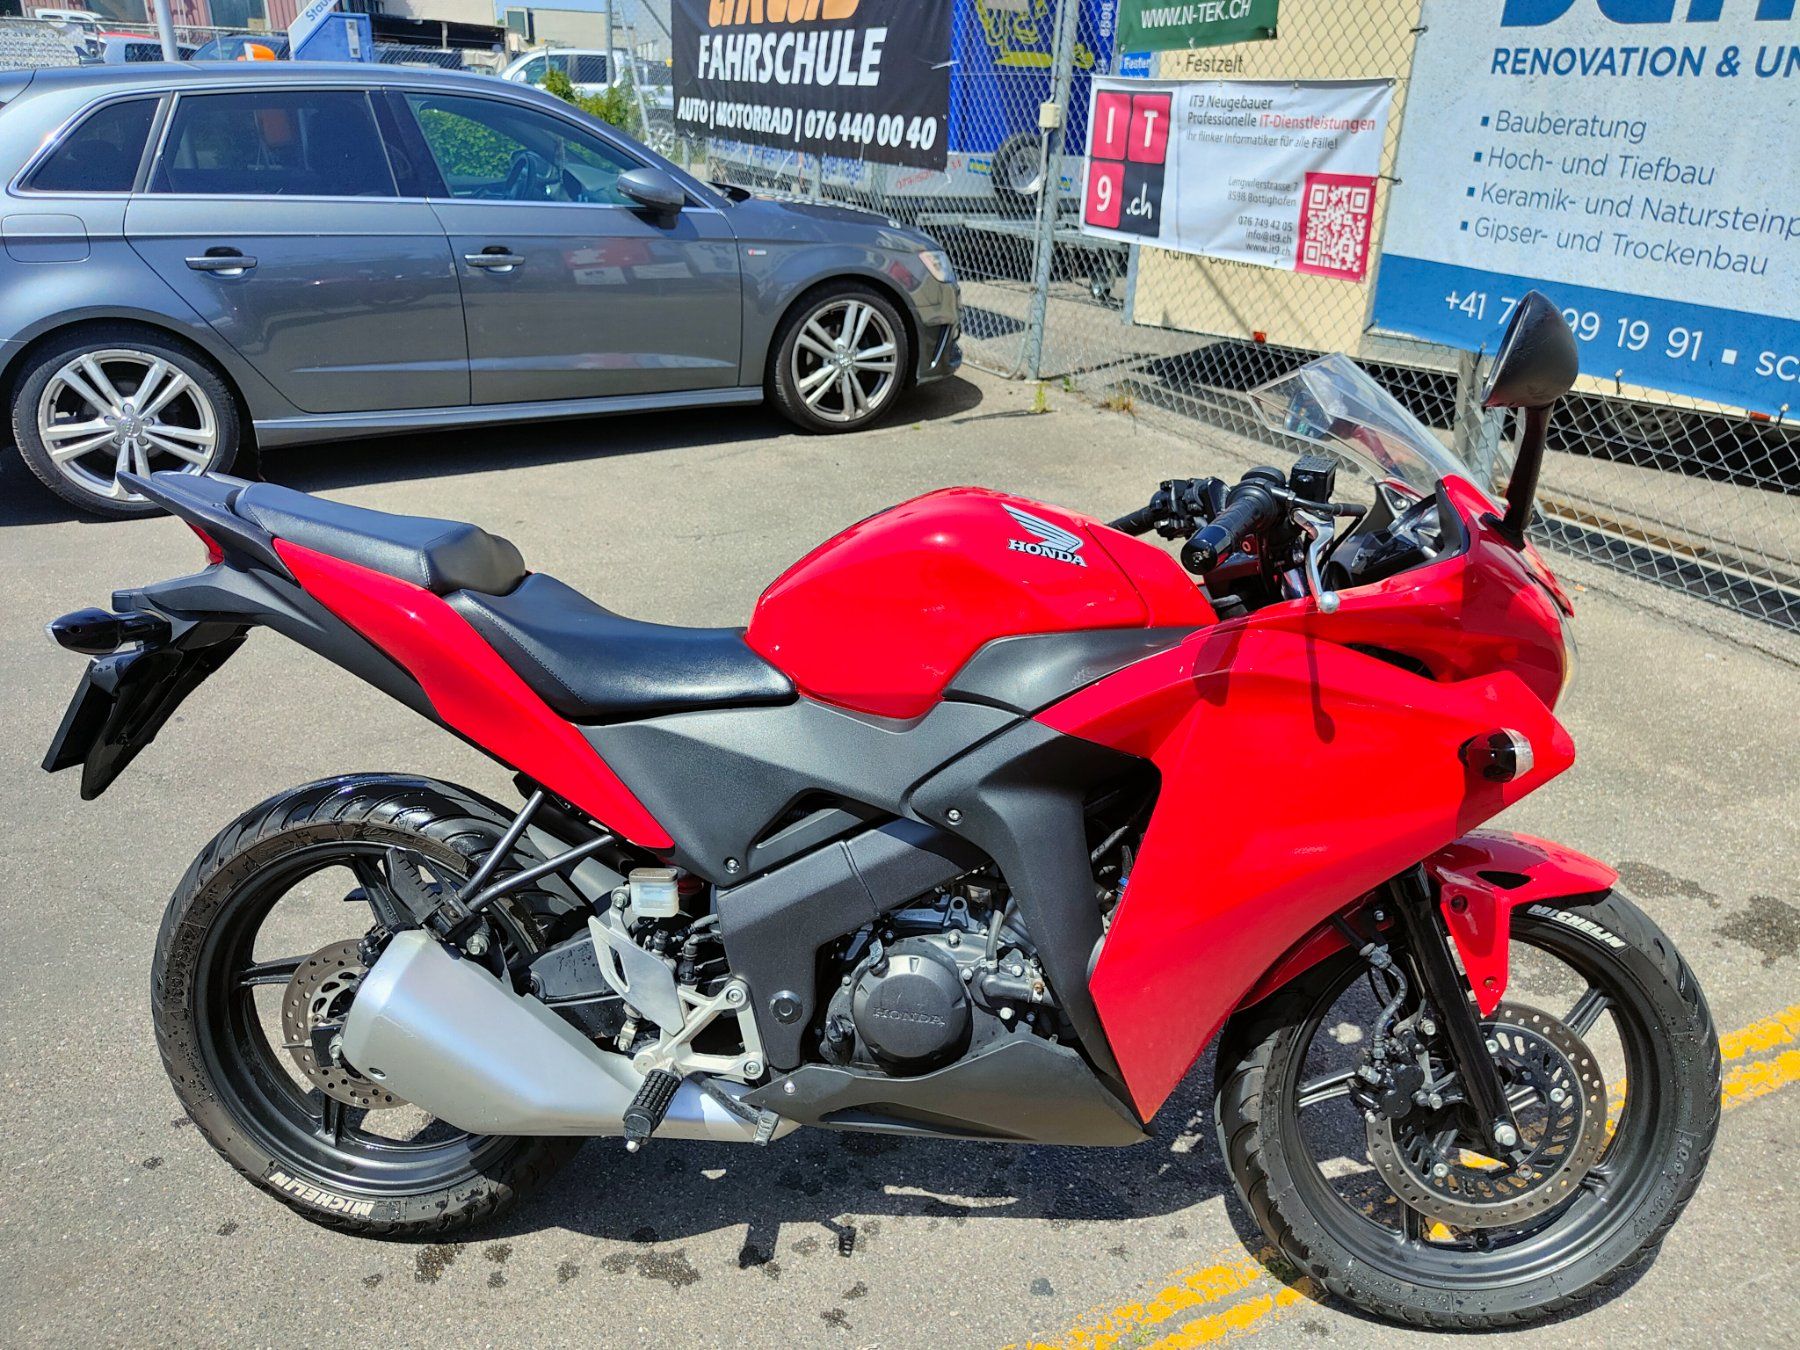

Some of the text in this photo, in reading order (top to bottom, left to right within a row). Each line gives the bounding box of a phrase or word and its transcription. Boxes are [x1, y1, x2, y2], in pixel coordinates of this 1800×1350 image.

[305, 0, 333, 21] Stau
[1141, 0, 1251, 29] WWW.N-TEK.CH
[698, 27, 888, 87] FAHRSCHULE
[1185, 54, 1243, 74] Festzelt
[1491, 45, 1707, 77] RENOVATION
[1715, 45, 1742, 77] &
[1189, 95, 1274, 112] IT9 Neugebauer
[677, 96, 709, 124] AUTO
[716, 101, 794, 136] MOTORRAD
[804, 110, 837, 141] 076
[838, 112, 875, 145] 440
[876, 113, 905, 148] 00
[906, 116, 938, 150] 40
[1187, 112, 1376, 134] Professionelle IT-Dienstleistungen
[1495, 110, 1647, 145] Bauberatung
[1224, 132, 1278, 147] Informatiker
[1279, 135, 1293, 147] für
[1311, 137, 1339, 150] Fälle!
[1488, 146, 1715, 186] Hoch- und Tiefbau
[1481, 182, 1576, 212] Keramik-
[1585, 195, 1633, 218] und
[1245, 229, 1292, 244] info@it9.ch
[1245, 243, 1291, 256] www.it9.ch
[1474, 217, 1768, 276] Gipser- und Trockenbau
[1445, 290, 1487, 320] +41
[1617, 318, 1650, 351] 19
[1666, 327, 1703, 362] 91
[1007, 539, 1088, 568] HONDA
[1527, 904, 1627, 948] MICHELIN
[872, 1006, 946, 1027] HONDA
[267, 1171, 376, 1218] MICHELIN
